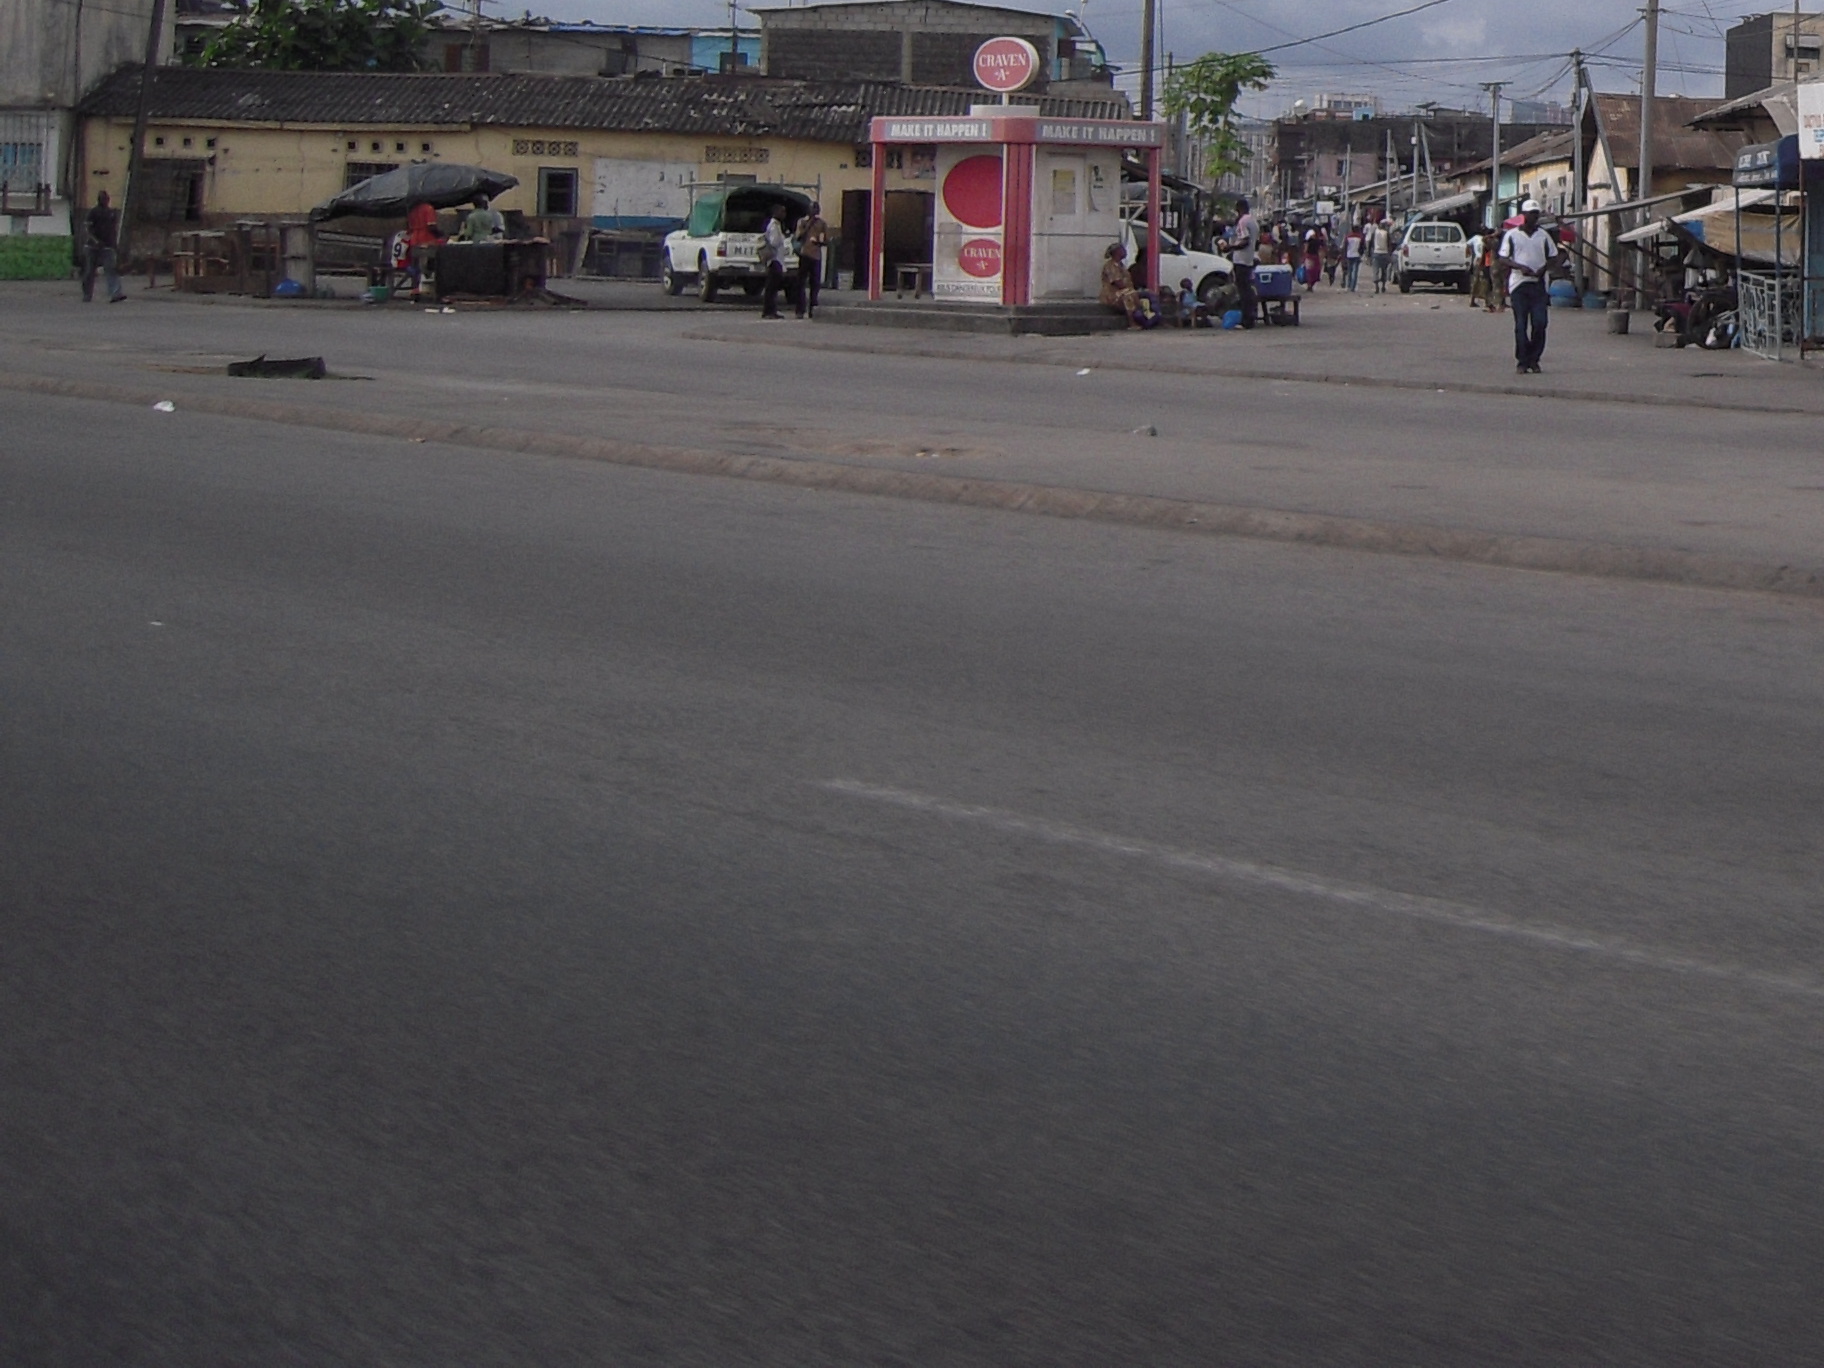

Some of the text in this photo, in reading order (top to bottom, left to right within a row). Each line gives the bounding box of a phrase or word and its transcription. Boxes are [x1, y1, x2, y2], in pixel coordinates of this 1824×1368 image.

[979, 53, 1027, 67] CRAVEN
[891, 122, 921, 137] MAKE
[923, 122, 934, 136] IT
[937, 122, 980, 137] HAPPEN
[1042, 125, 1079, 139] MAKE
[1082, 126, 1094, 139] IT
[1099, 127, 1147, 142] HAPPEN
